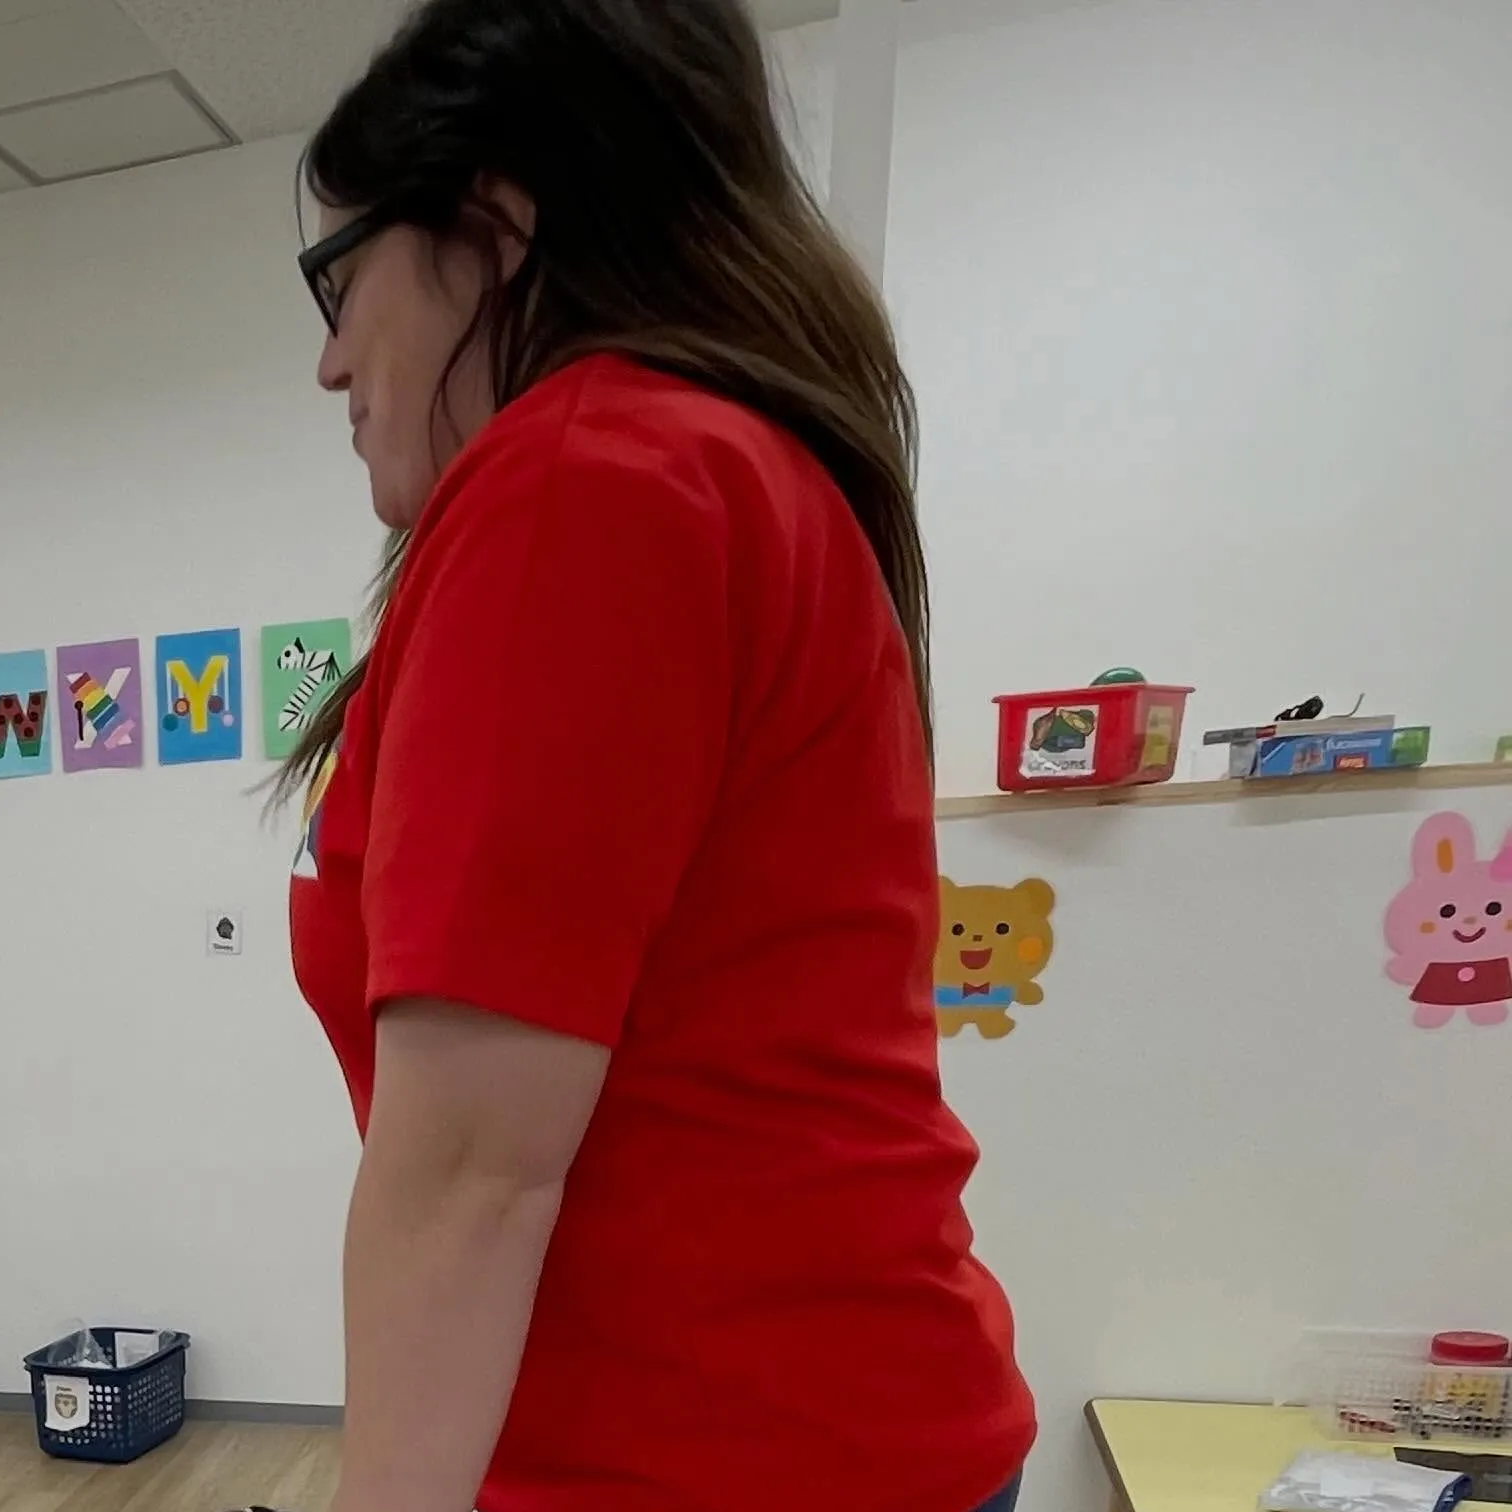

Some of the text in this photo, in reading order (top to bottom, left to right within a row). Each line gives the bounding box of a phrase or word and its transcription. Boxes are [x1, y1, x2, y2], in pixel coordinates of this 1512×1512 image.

[64, 667, 133, 750] X
[165, 655, 230, 733] Y
[278, 643, 336, 732] Z
